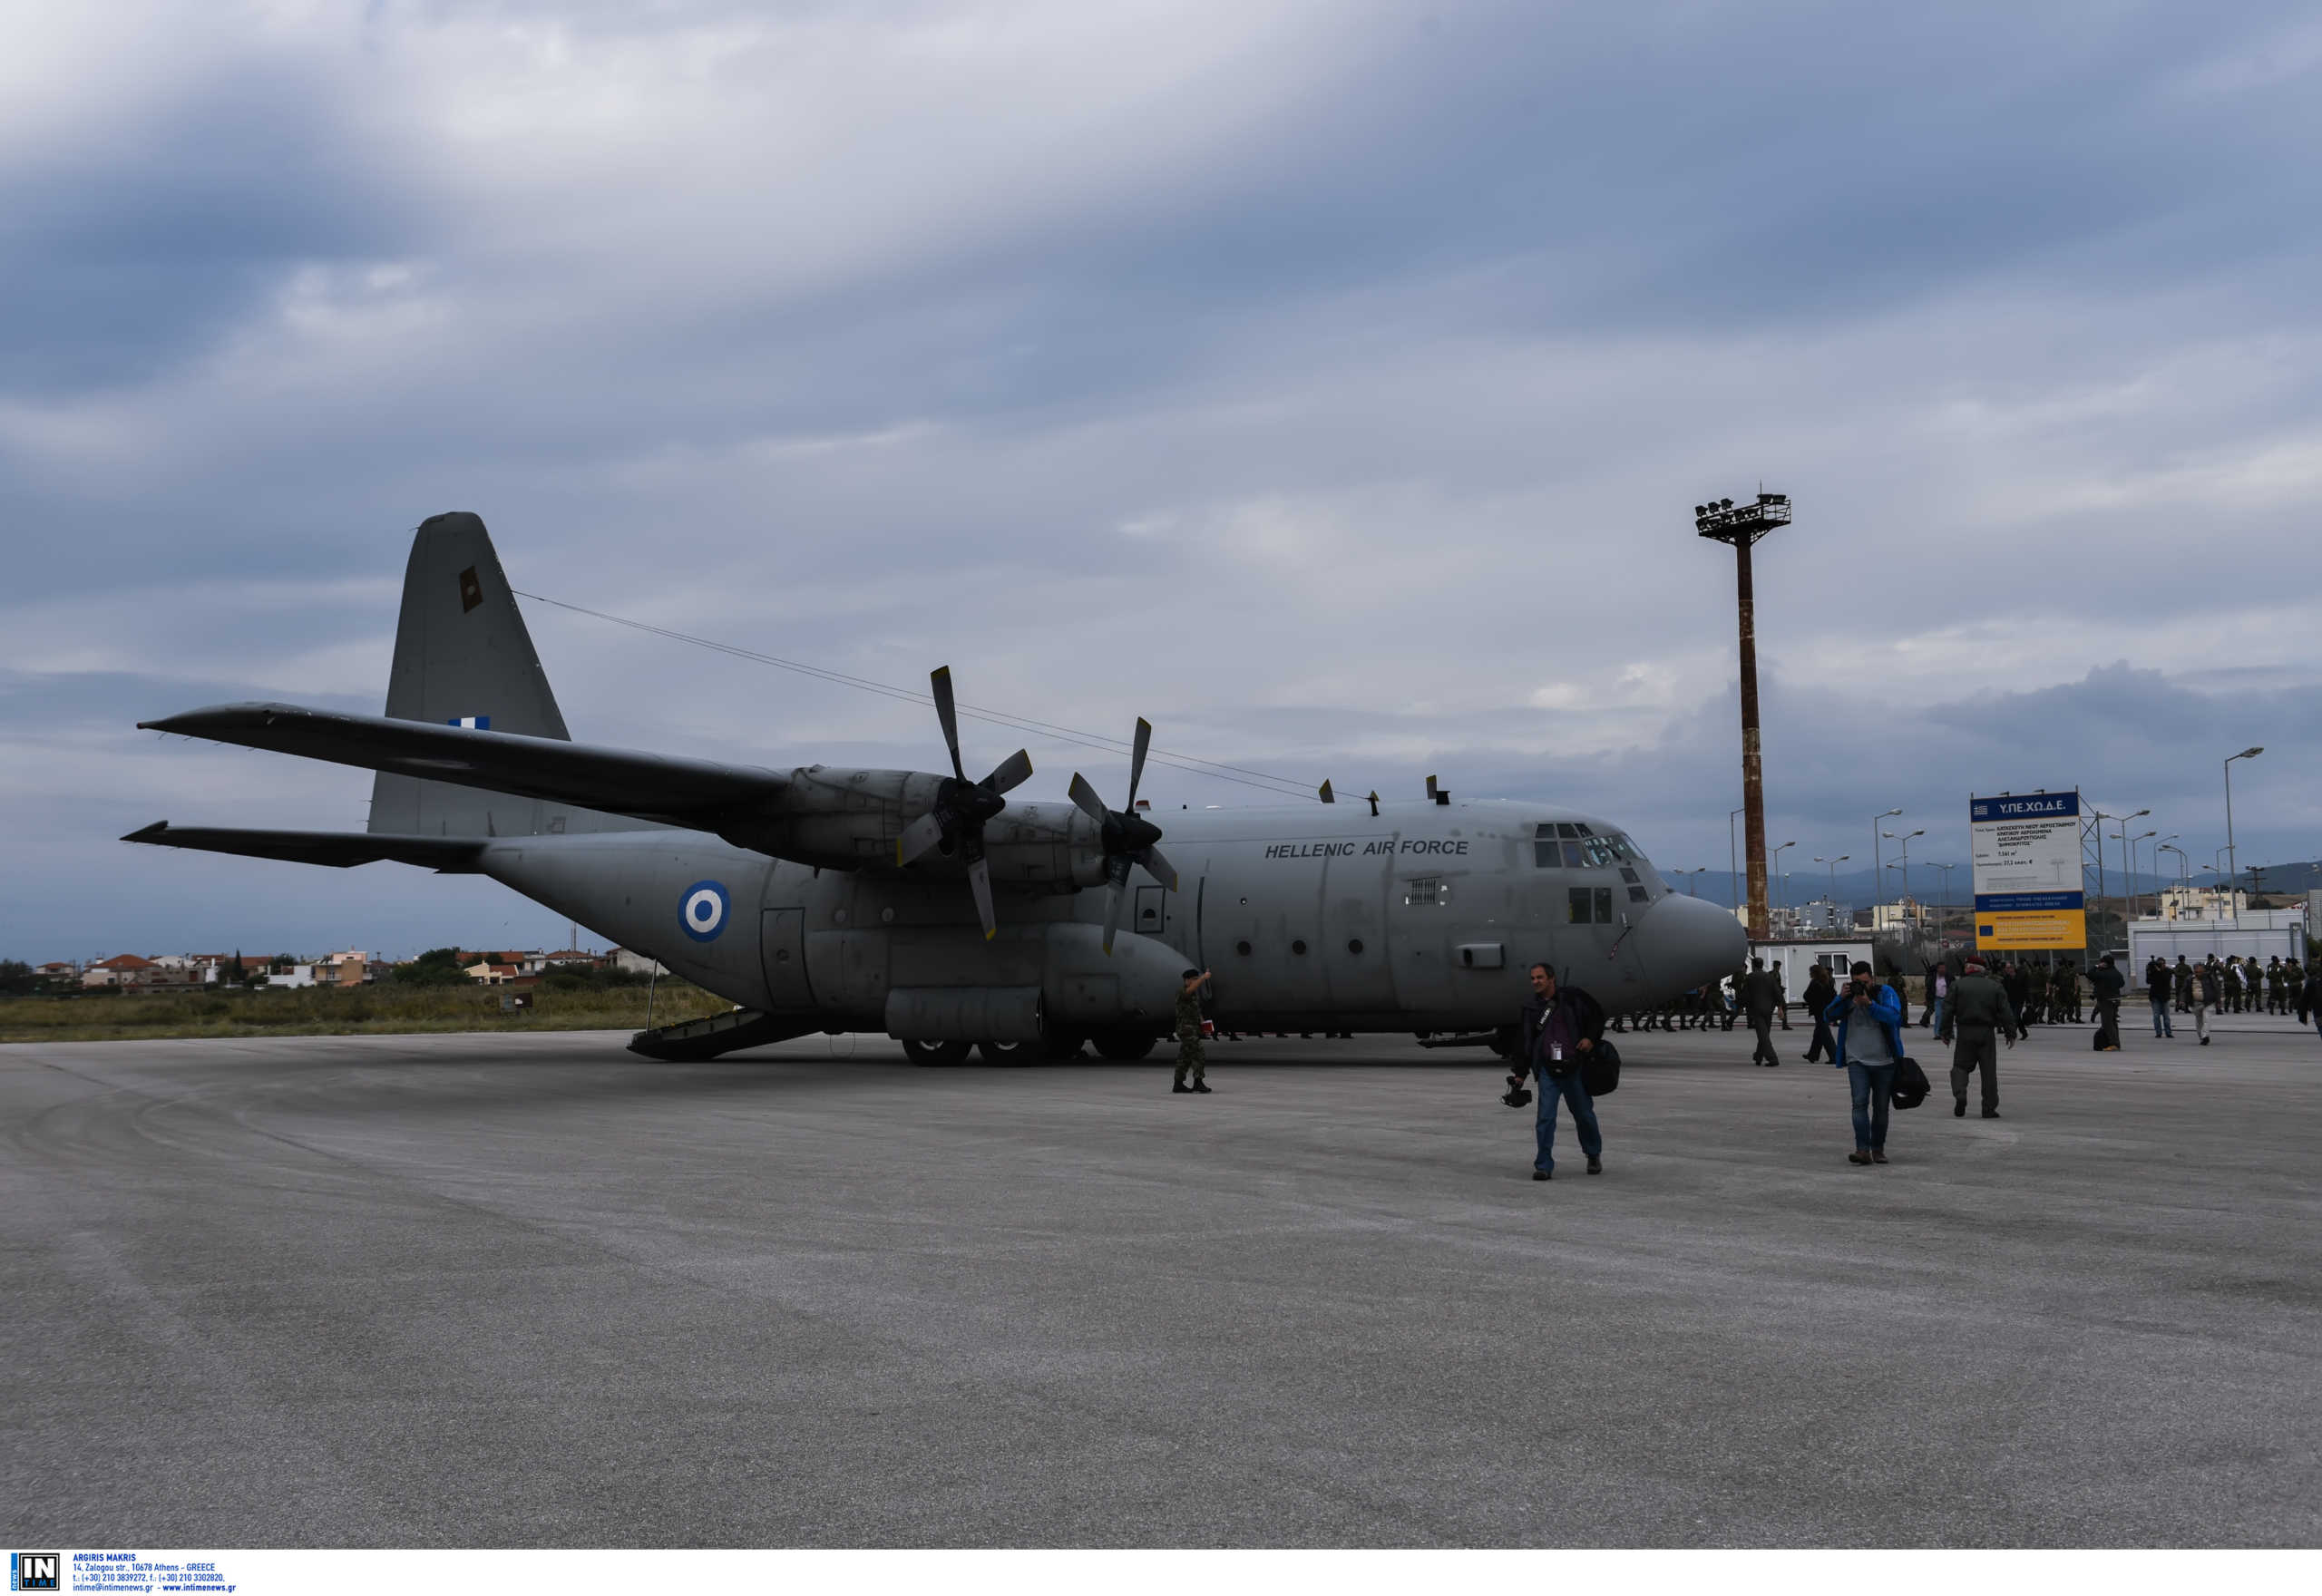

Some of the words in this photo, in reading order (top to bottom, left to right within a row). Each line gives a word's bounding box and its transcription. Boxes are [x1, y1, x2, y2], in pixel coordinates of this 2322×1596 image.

[1999, 800, 2066, 813] Υ.ΠΕ.ΧΩ.Δ.Ε.
[1265, 842, 1355, 859] HELLENIC
[1362, 841, 1395, 855] AIR
[1400, 841, 1469, 855] FORCE
